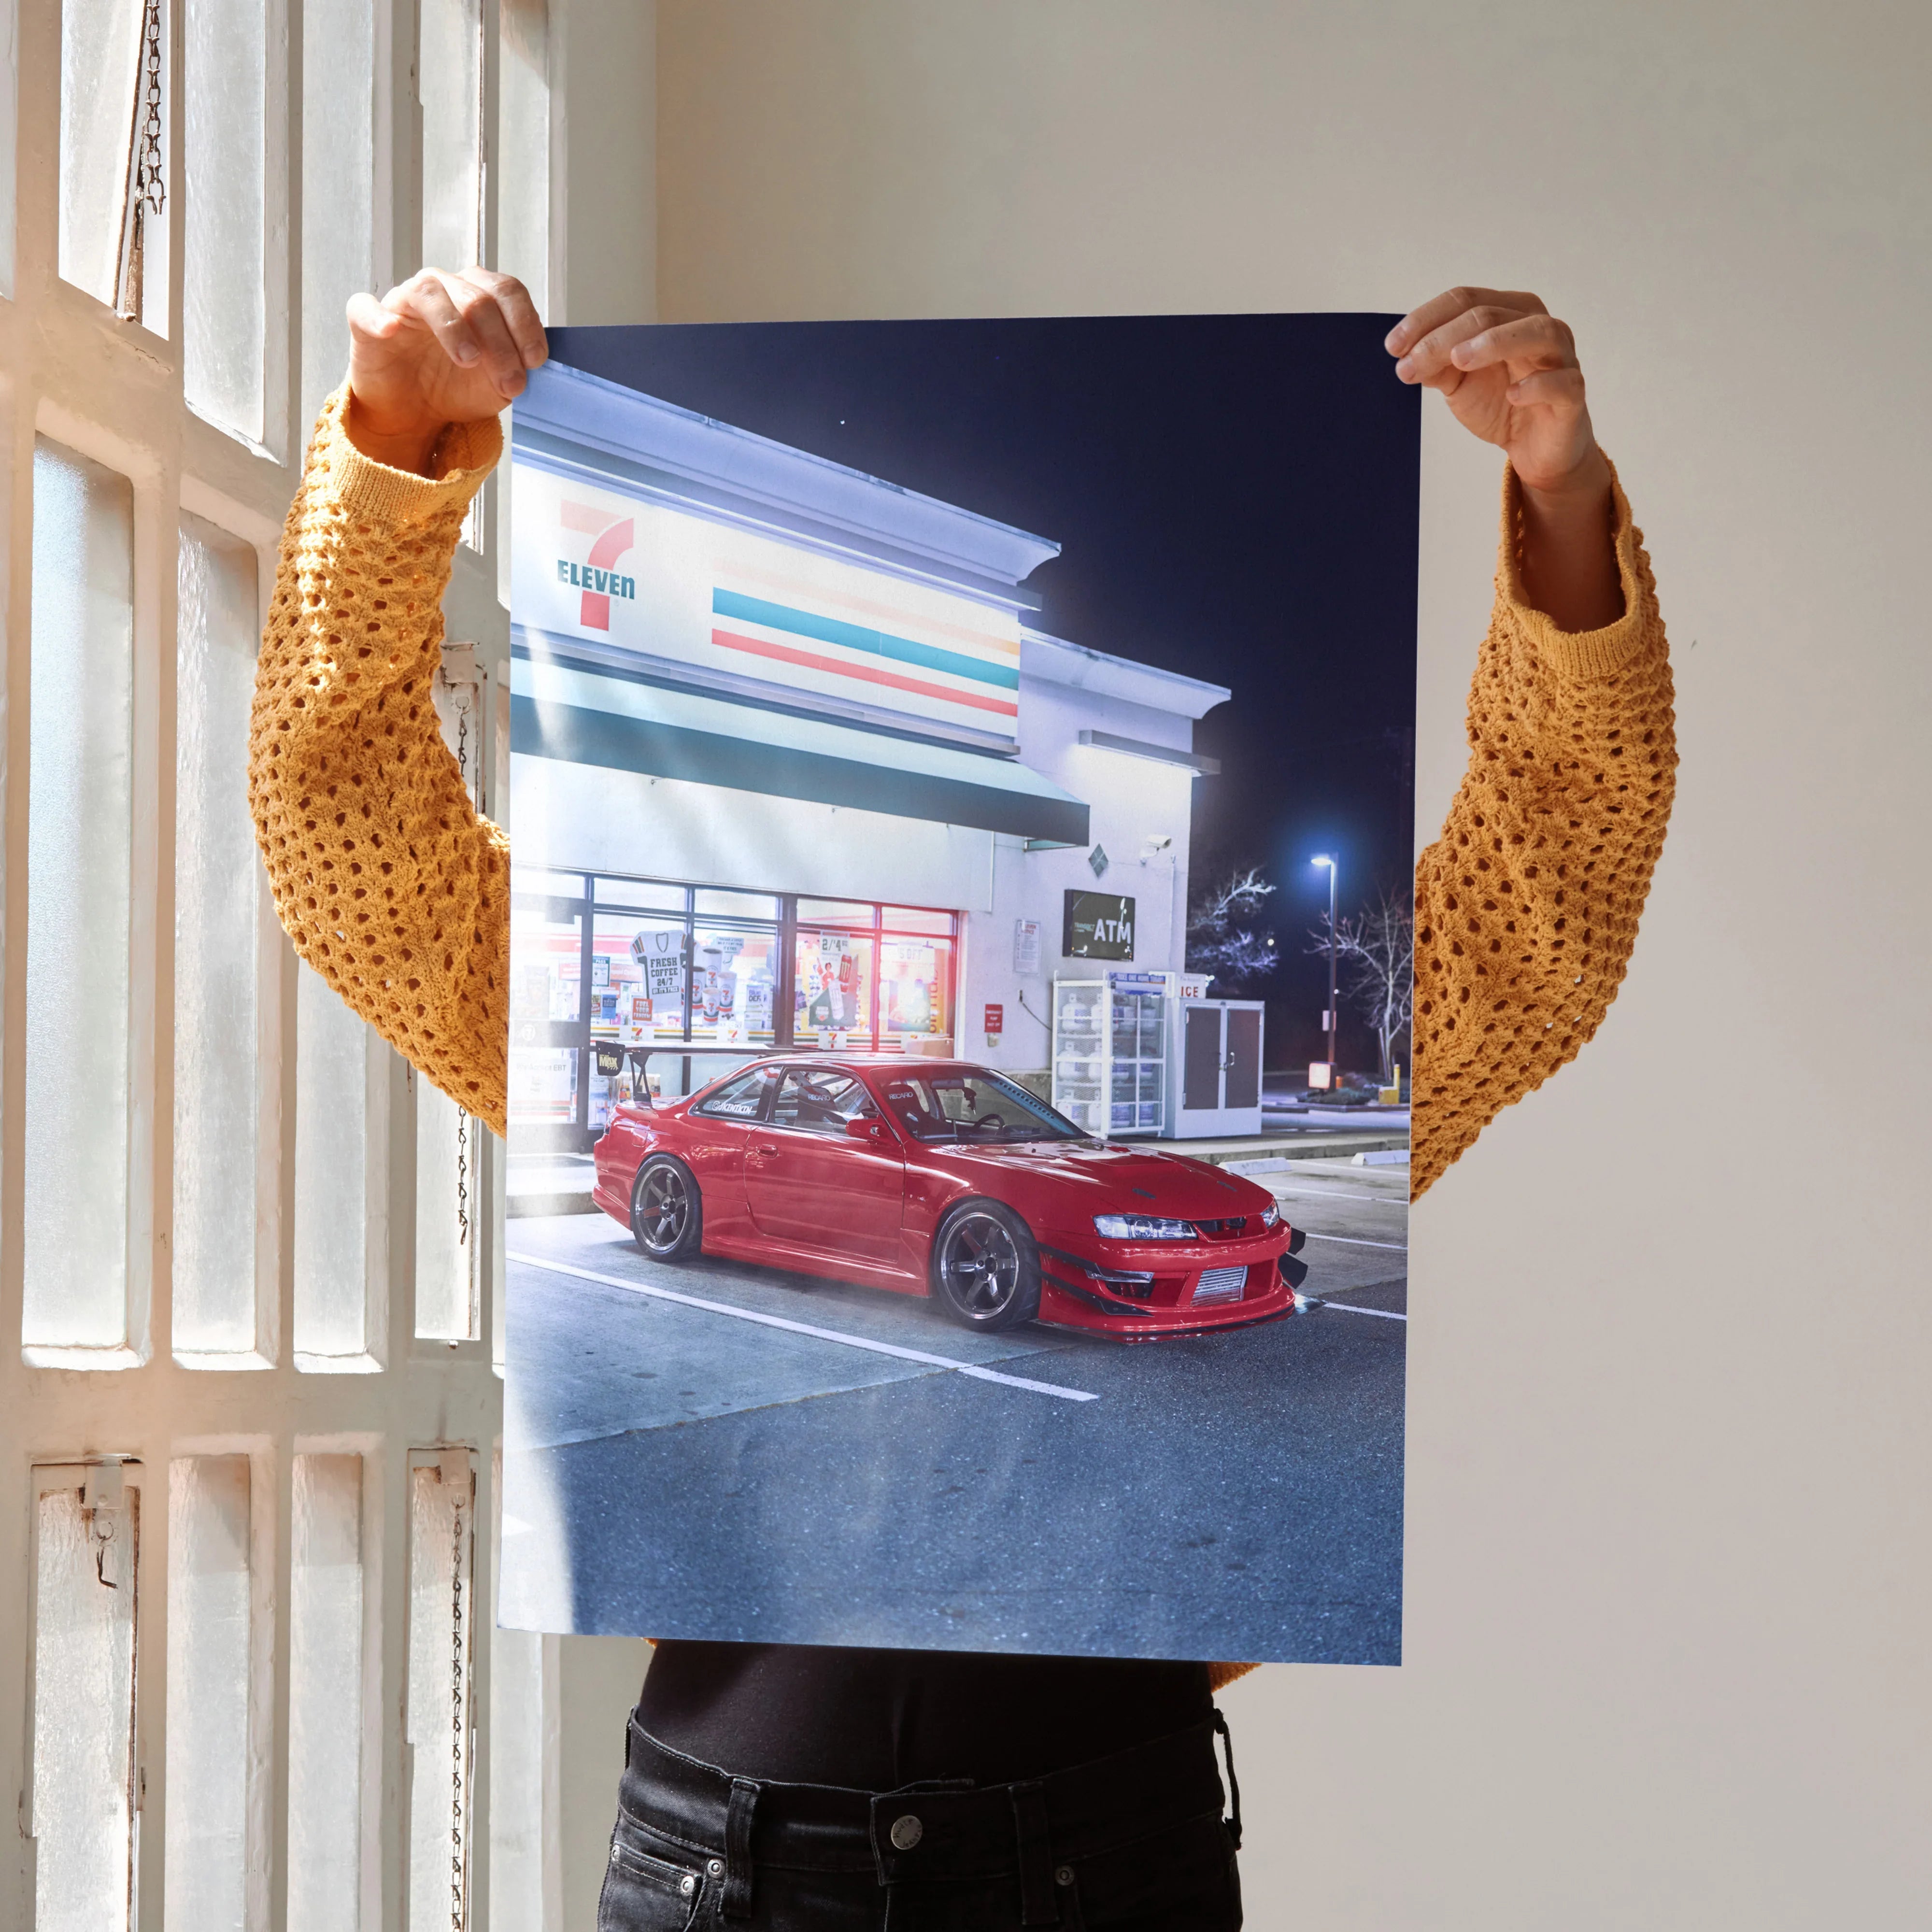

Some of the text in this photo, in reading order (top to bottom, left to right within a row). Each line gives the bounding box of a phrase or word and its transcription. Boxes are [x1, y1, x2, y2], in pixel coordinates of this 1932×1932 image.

[560, 498, 634, 632] 7
[1094, 918, 1131, 944] ATM
[650, 957, 677, 968] FRESH
[651, 967, 678, 978] COFFEE
[657, 977, 673, 986] 24/7
[1181, 986, 1198, 997] ICE
[599, 1056, 618, 1067] MAX
[889, 1092, 913, 1100] RECARO
